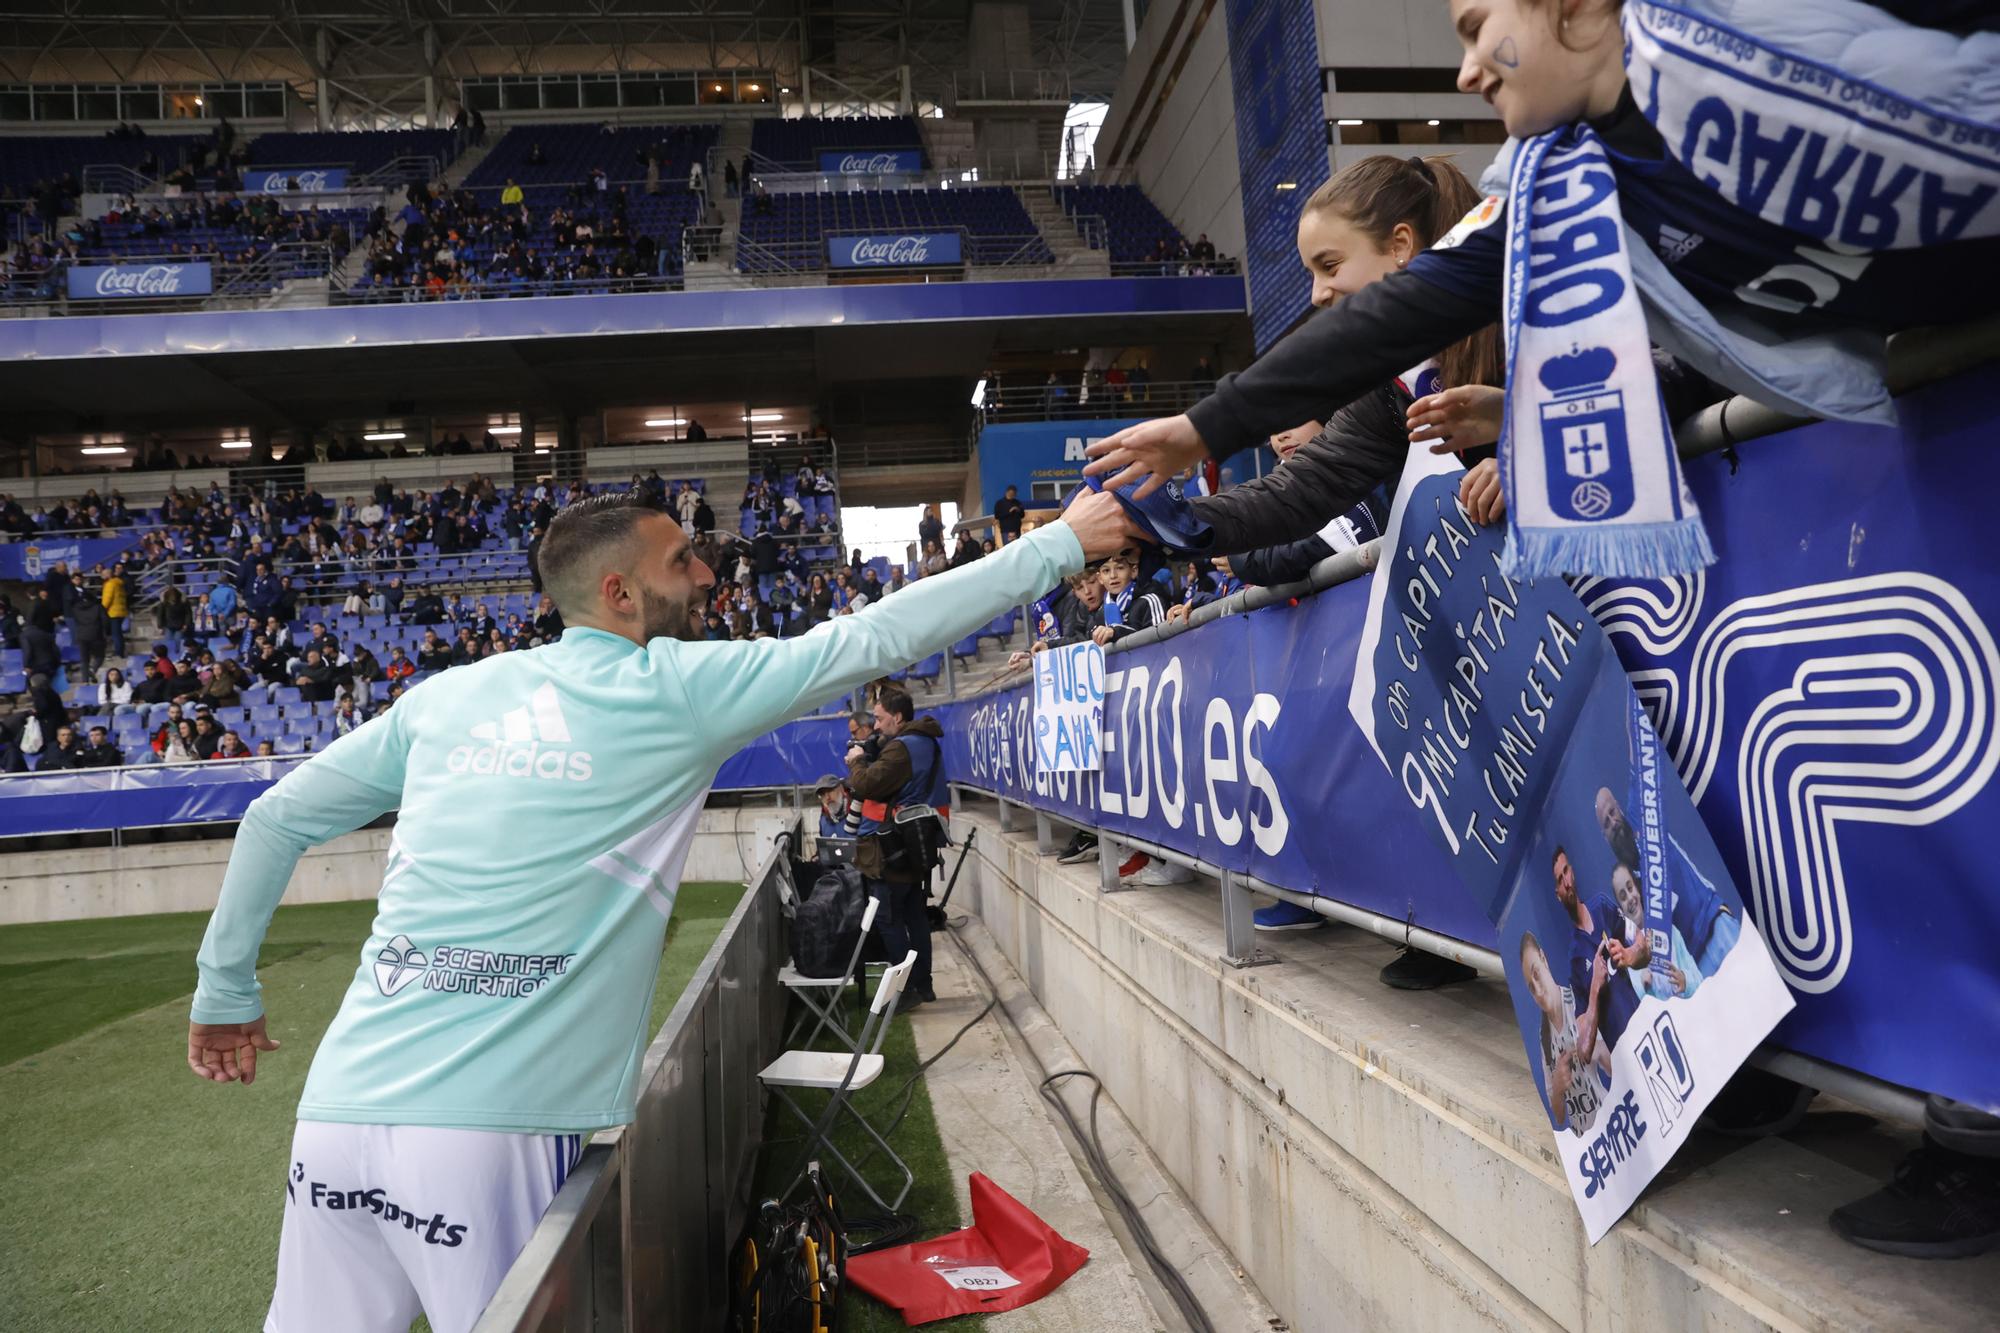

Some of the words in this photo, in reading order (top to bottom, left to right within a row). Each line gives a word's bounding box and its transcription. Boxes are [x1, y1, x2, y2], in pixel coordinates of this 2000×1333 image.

[1514, 193, 1530, 234] Real
[95, 265, 183, 295] Coca-Cola
[851, 236, 931, 265] Coca-Cola
[1509, 260, 1526, 320] Oviedo
[1033, 645, 1105, 709] HUGO
[446, 739, 594, 782] adidas
[1637, 698, 1664, 921] INQUEBRANTA
[1579, 1089, 1648, 1199] SIEMPRE
[310, 1181, 468, 1248] FanSports
